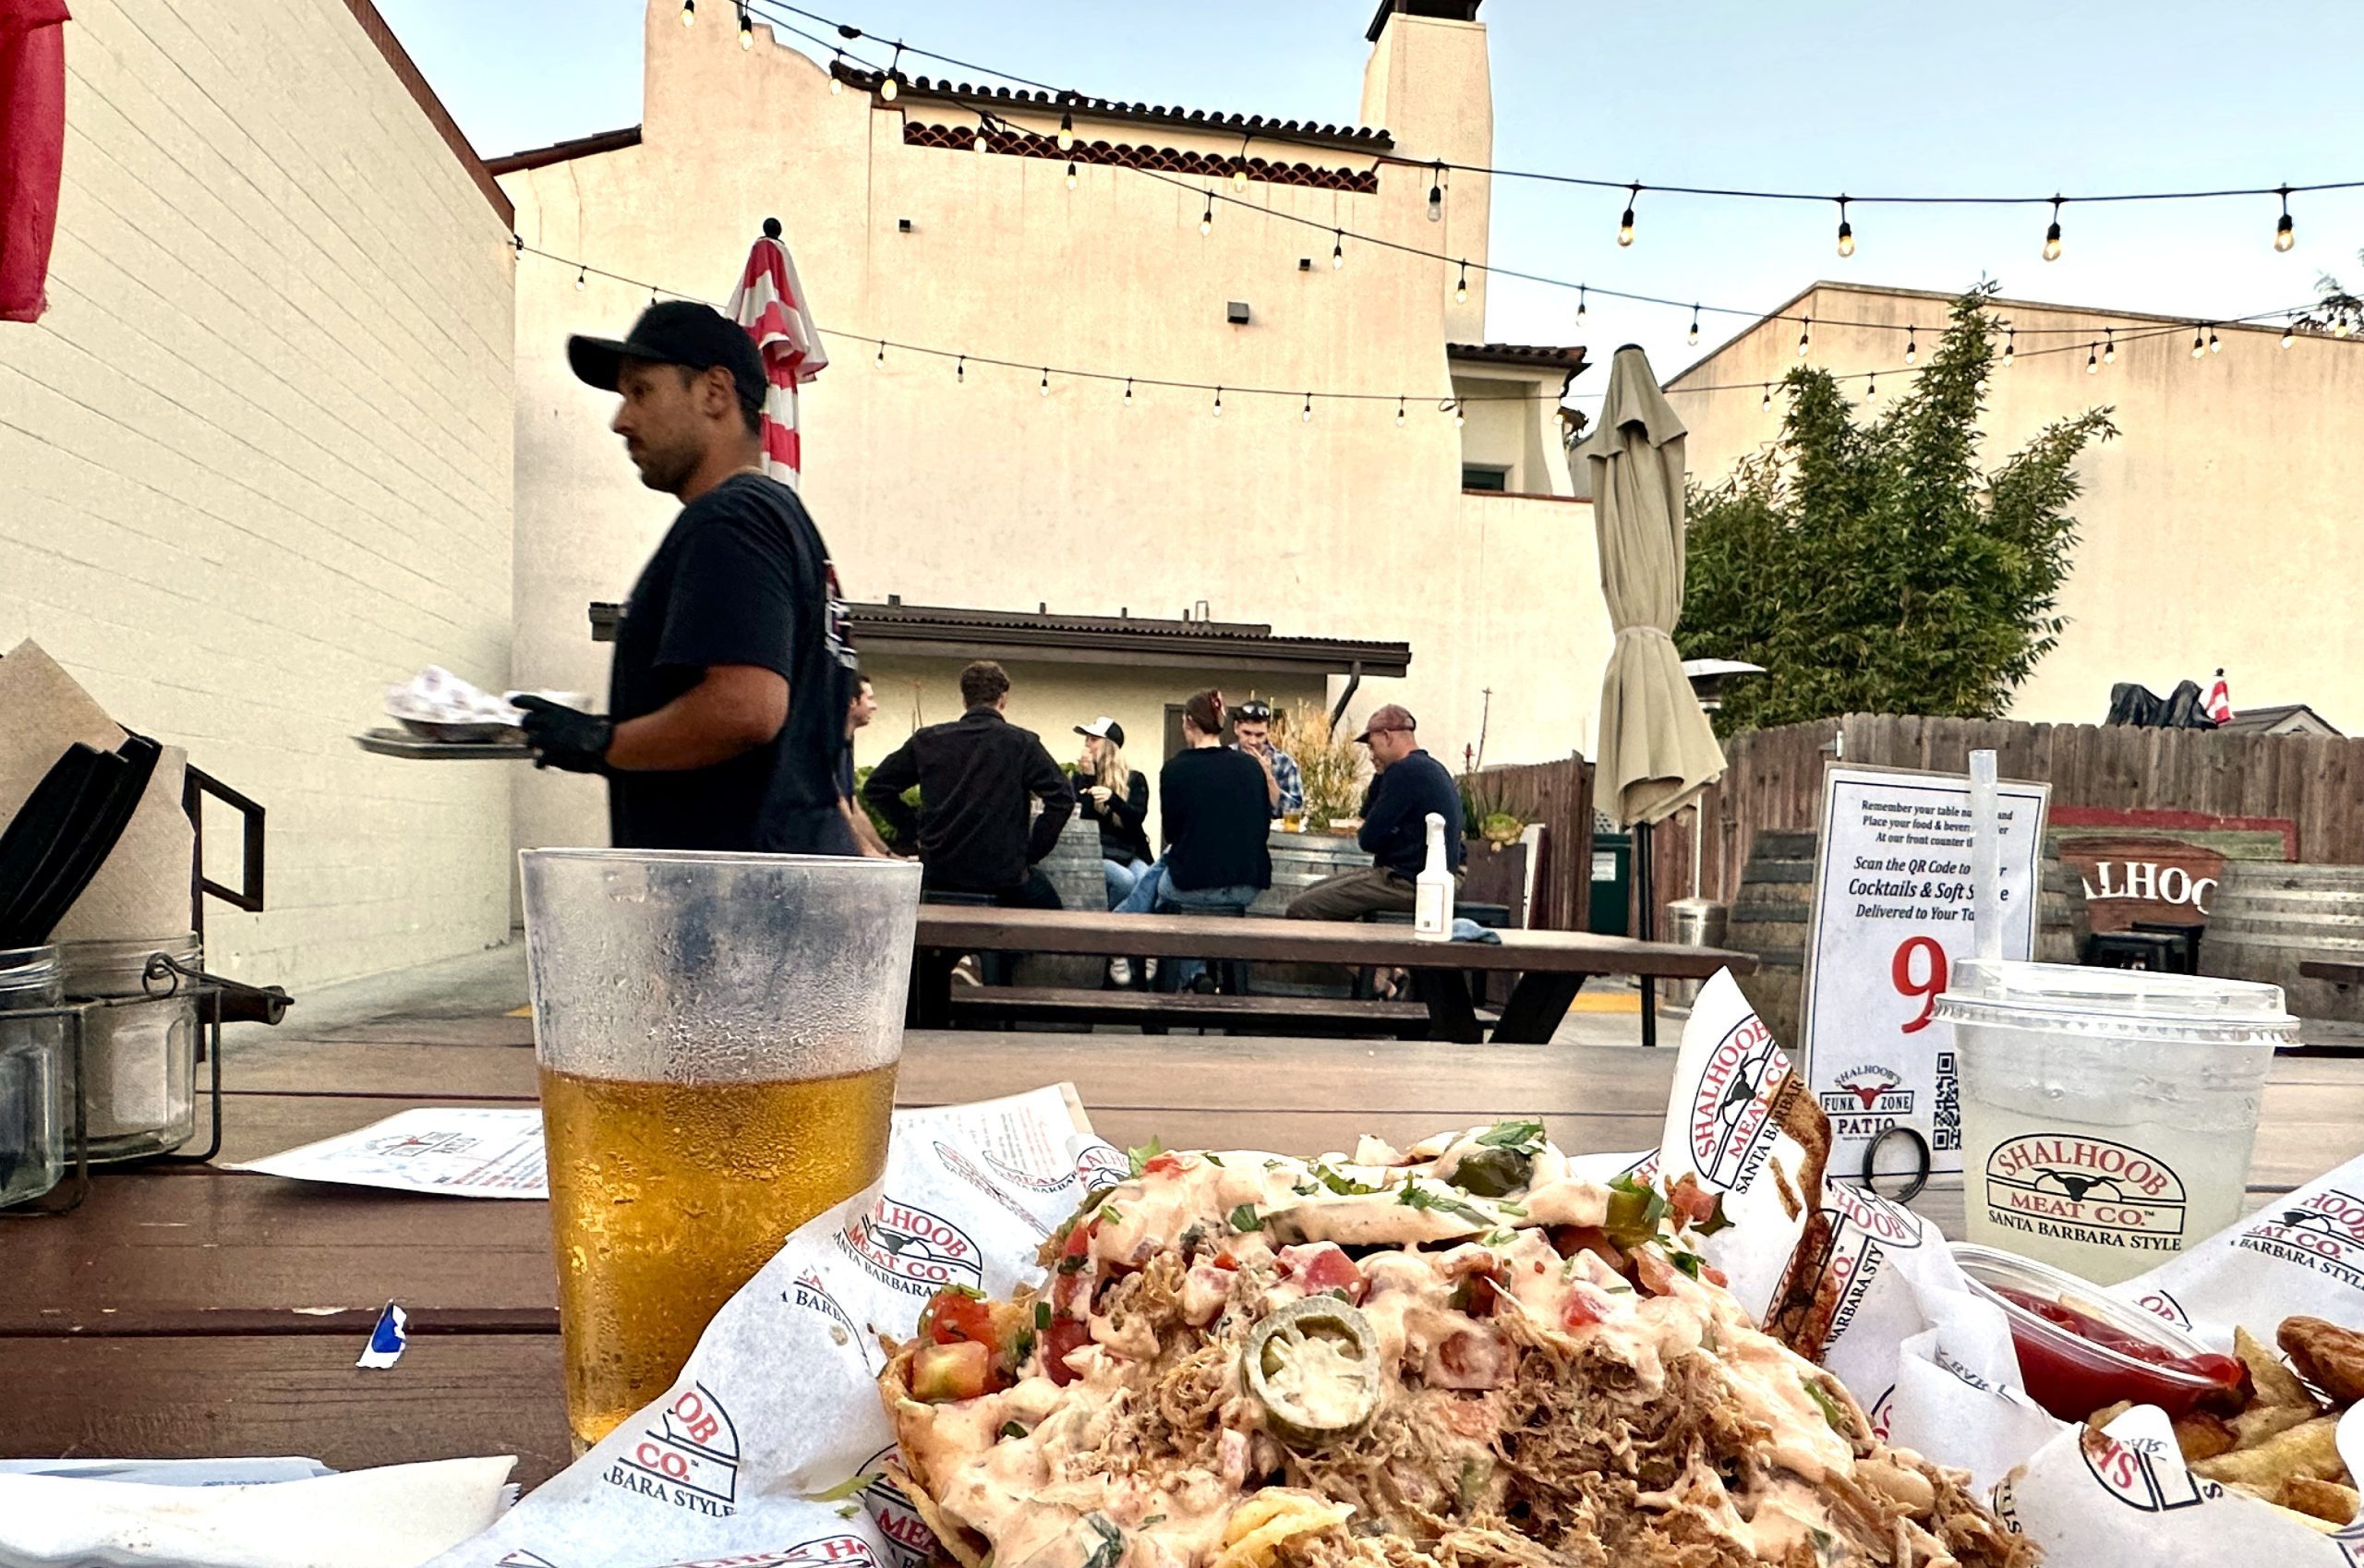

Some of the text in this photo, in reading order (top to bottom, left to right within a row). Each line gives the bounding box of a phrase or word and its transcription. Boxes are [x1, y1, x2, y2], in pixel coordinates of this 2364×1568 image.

[1862, 800, 1912, 814] Remember
[1914, 806, 1936, 817] your
[1937, 806, 1960, 816] table
[1863, 815, 1971, 833] Place your food & bever
[1876, 832, 1887, 842] At
[1888, 835, 1904, 844] our
[1906, 834, 1928, 845] front
[1930, 837, 1965, 848] counter
[1853, 856, 1972, 875] Scan the QR Code to
[1849, 878, 1918, 898] Cocktails
[1920, 881, 1932, 899] &
[1935, 882, 1966, 903] Soft
[1855, 904, 1914, 920] Delivered
[1915, 907, 1928, 920] to
[1931, 907, 1958, 921] Your
[1891, 935, 1947, 1033] 9
[1695, 1019, 1771, 1159] SHALHOOB
[1824, 1096, 1910, 1111] FUNK ZONE
[1728, 1091, 1768, 1159] MEAT
[1735, 1079, 1804, 1195] SANTA BARBAR
[1837, 1117, 1896, 1134] PATIO
[1997, 1140, 2168, 1196] SHALHOOB
[2010, 1191, 2086, 1219] MEAT
[849, 1223, 899, 1271] MEAT
[1989, 1211, 2182, 1251] SANTA BARBARA STYLE
[833, 1231, 862, 1266] ANTA
[864, 1261, 933, 1297] BARBARA
[1863, 1243, 1885, 1276] STY
[603, 1465, 669, 1502] BARA
